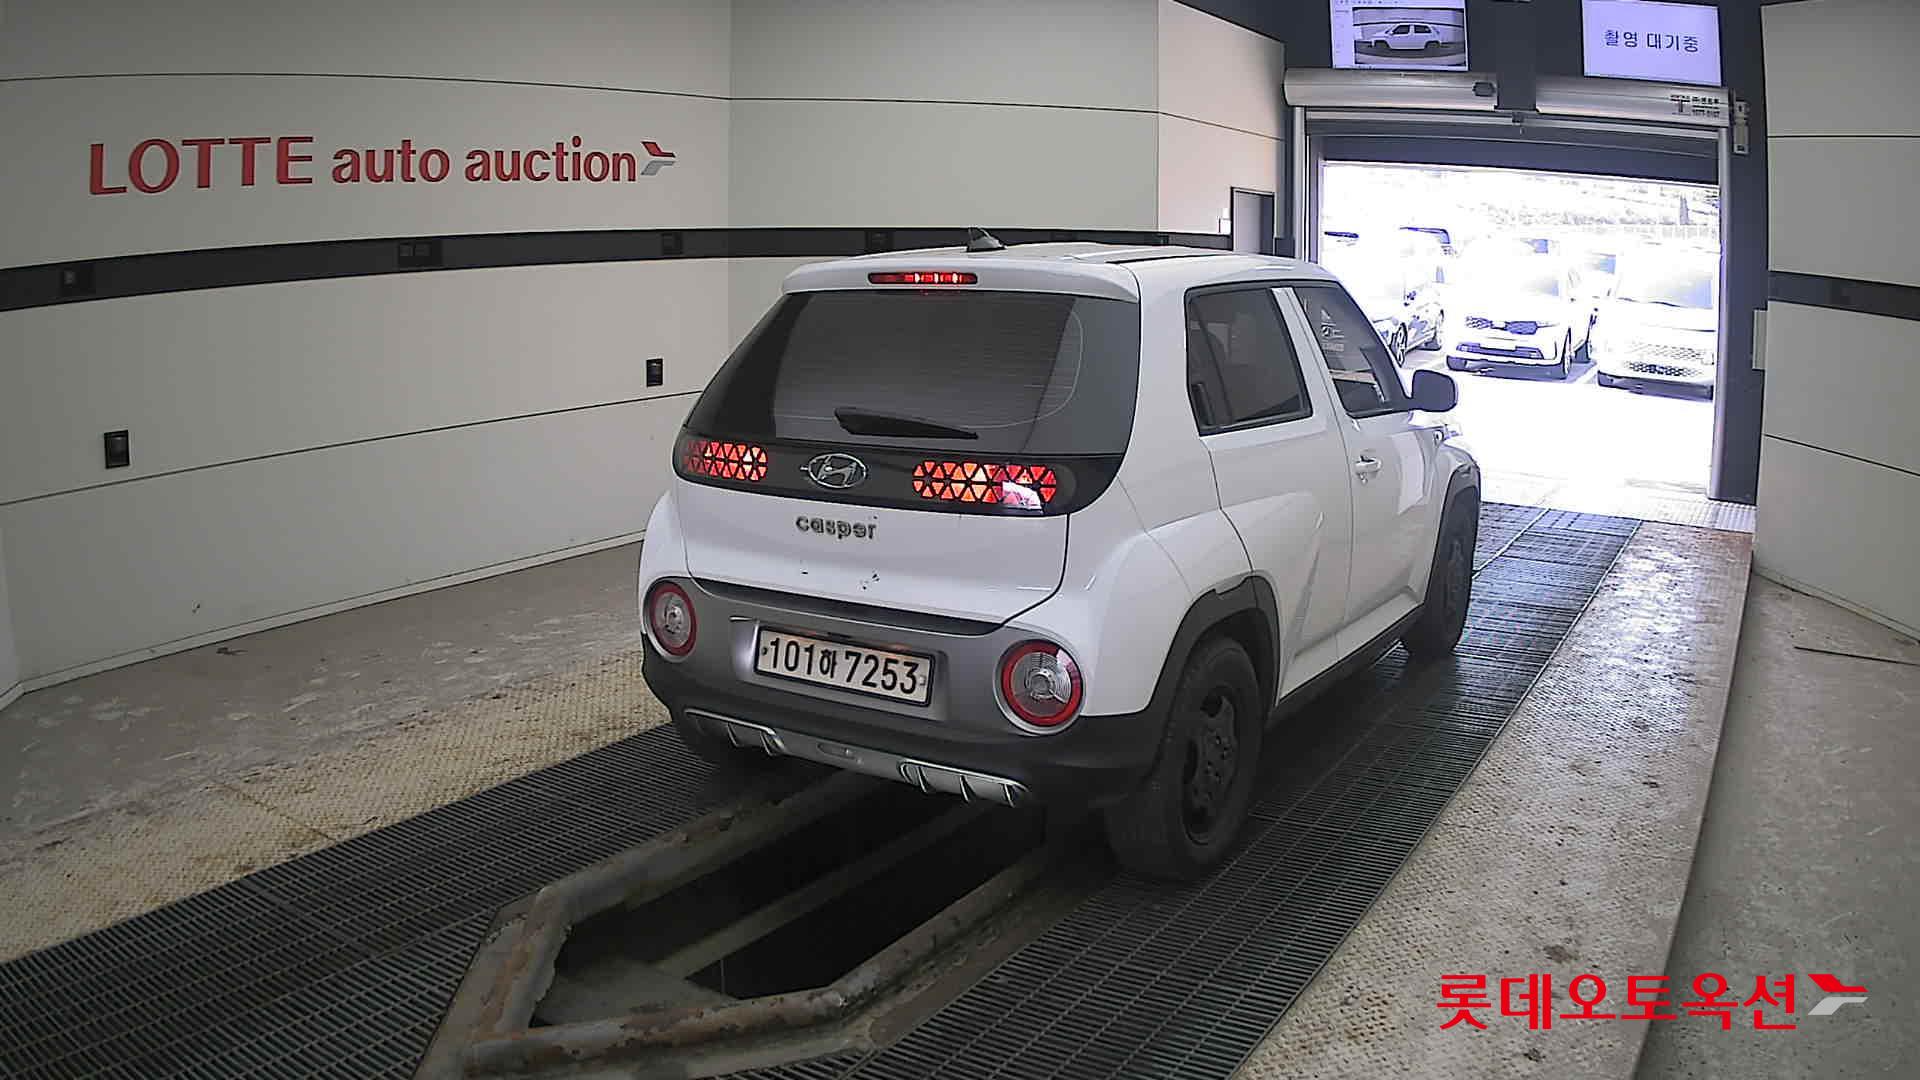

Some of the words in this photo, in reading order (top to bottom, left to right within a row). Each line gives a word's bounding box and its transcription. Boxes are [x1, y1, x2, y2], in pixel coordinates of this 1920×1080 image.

[1646, 33, 1699, 53] 대기중
[90, 137, 313, 195] LOTTE
[332, 139, 450, 183] auto
[464, 136, 637, 182] auction
[795, 516, 876, 540] casper
[845, 651, 919, 694] 7253
